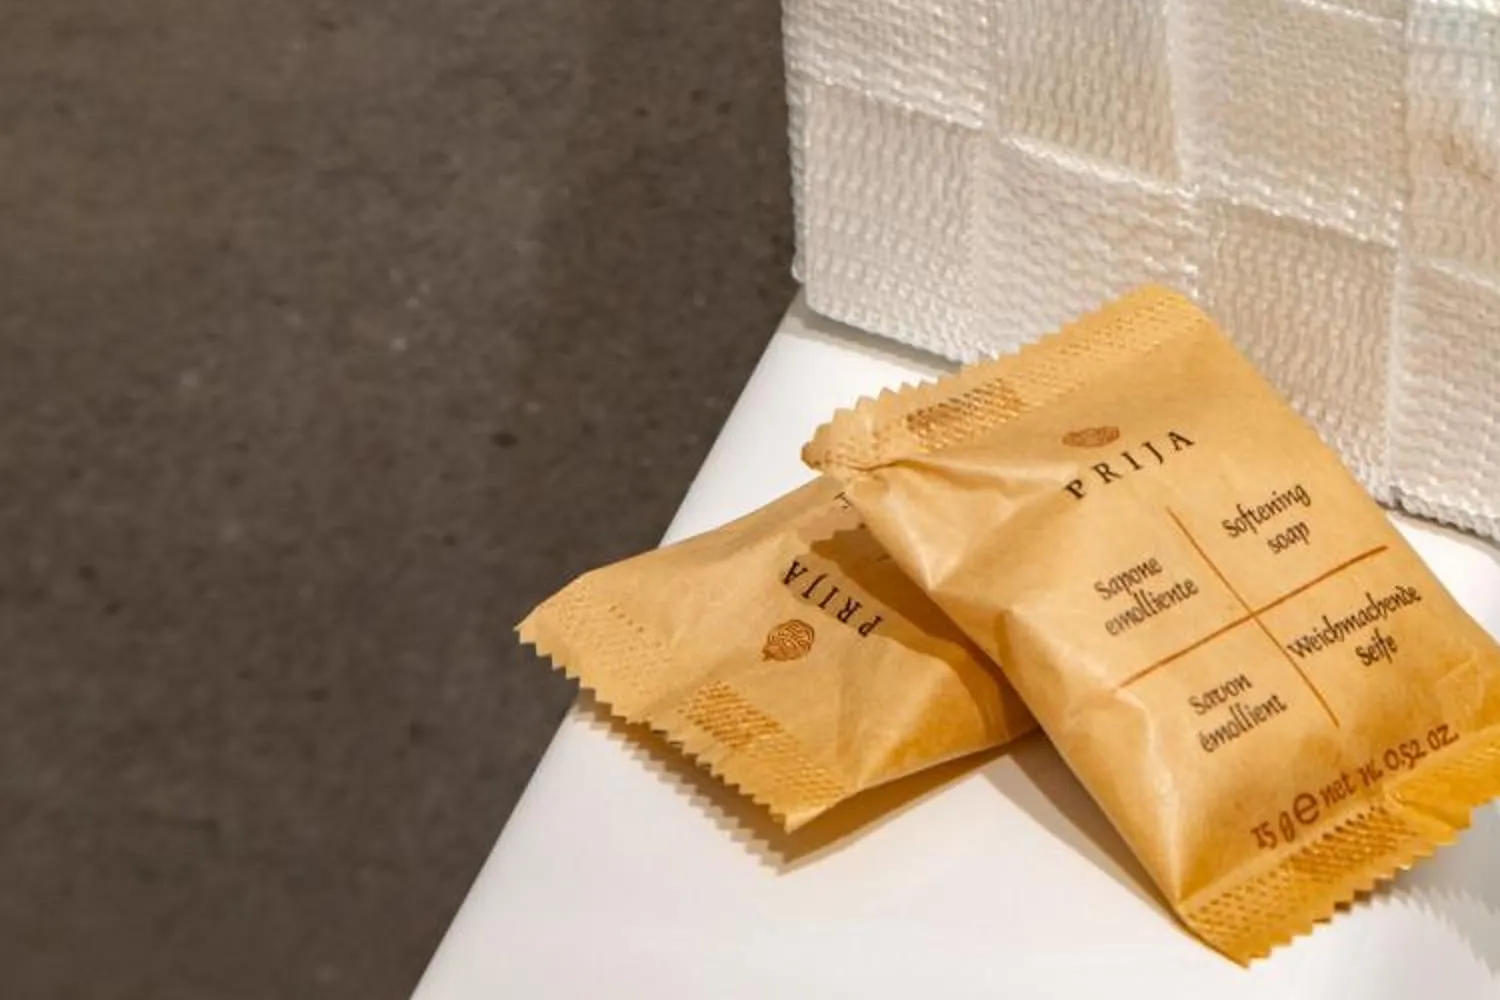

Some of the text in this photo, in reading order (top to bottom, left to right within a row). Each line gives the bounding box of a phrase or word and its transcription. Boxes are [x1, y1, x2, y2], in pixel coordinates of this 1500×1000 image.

[1065, 428, 1195, 500] PRIJA
[1222, 483, 1312, 539] Softening
[1268, 520, 1311, 554] soap
[781, 559, 883, 638] PRIJA
[1094, 556, 1163, 601] Sapone
[1105, 576, 1199, 637] emolliente
[1287, 583, 1422, 660] Weichmachende
[1356, 633, 1398, 667] Seife
[1189, 672, 1252, 716] Savon
[1320, 773, 1356, 807] net
[1426, 723, 1460, 752] oz.
